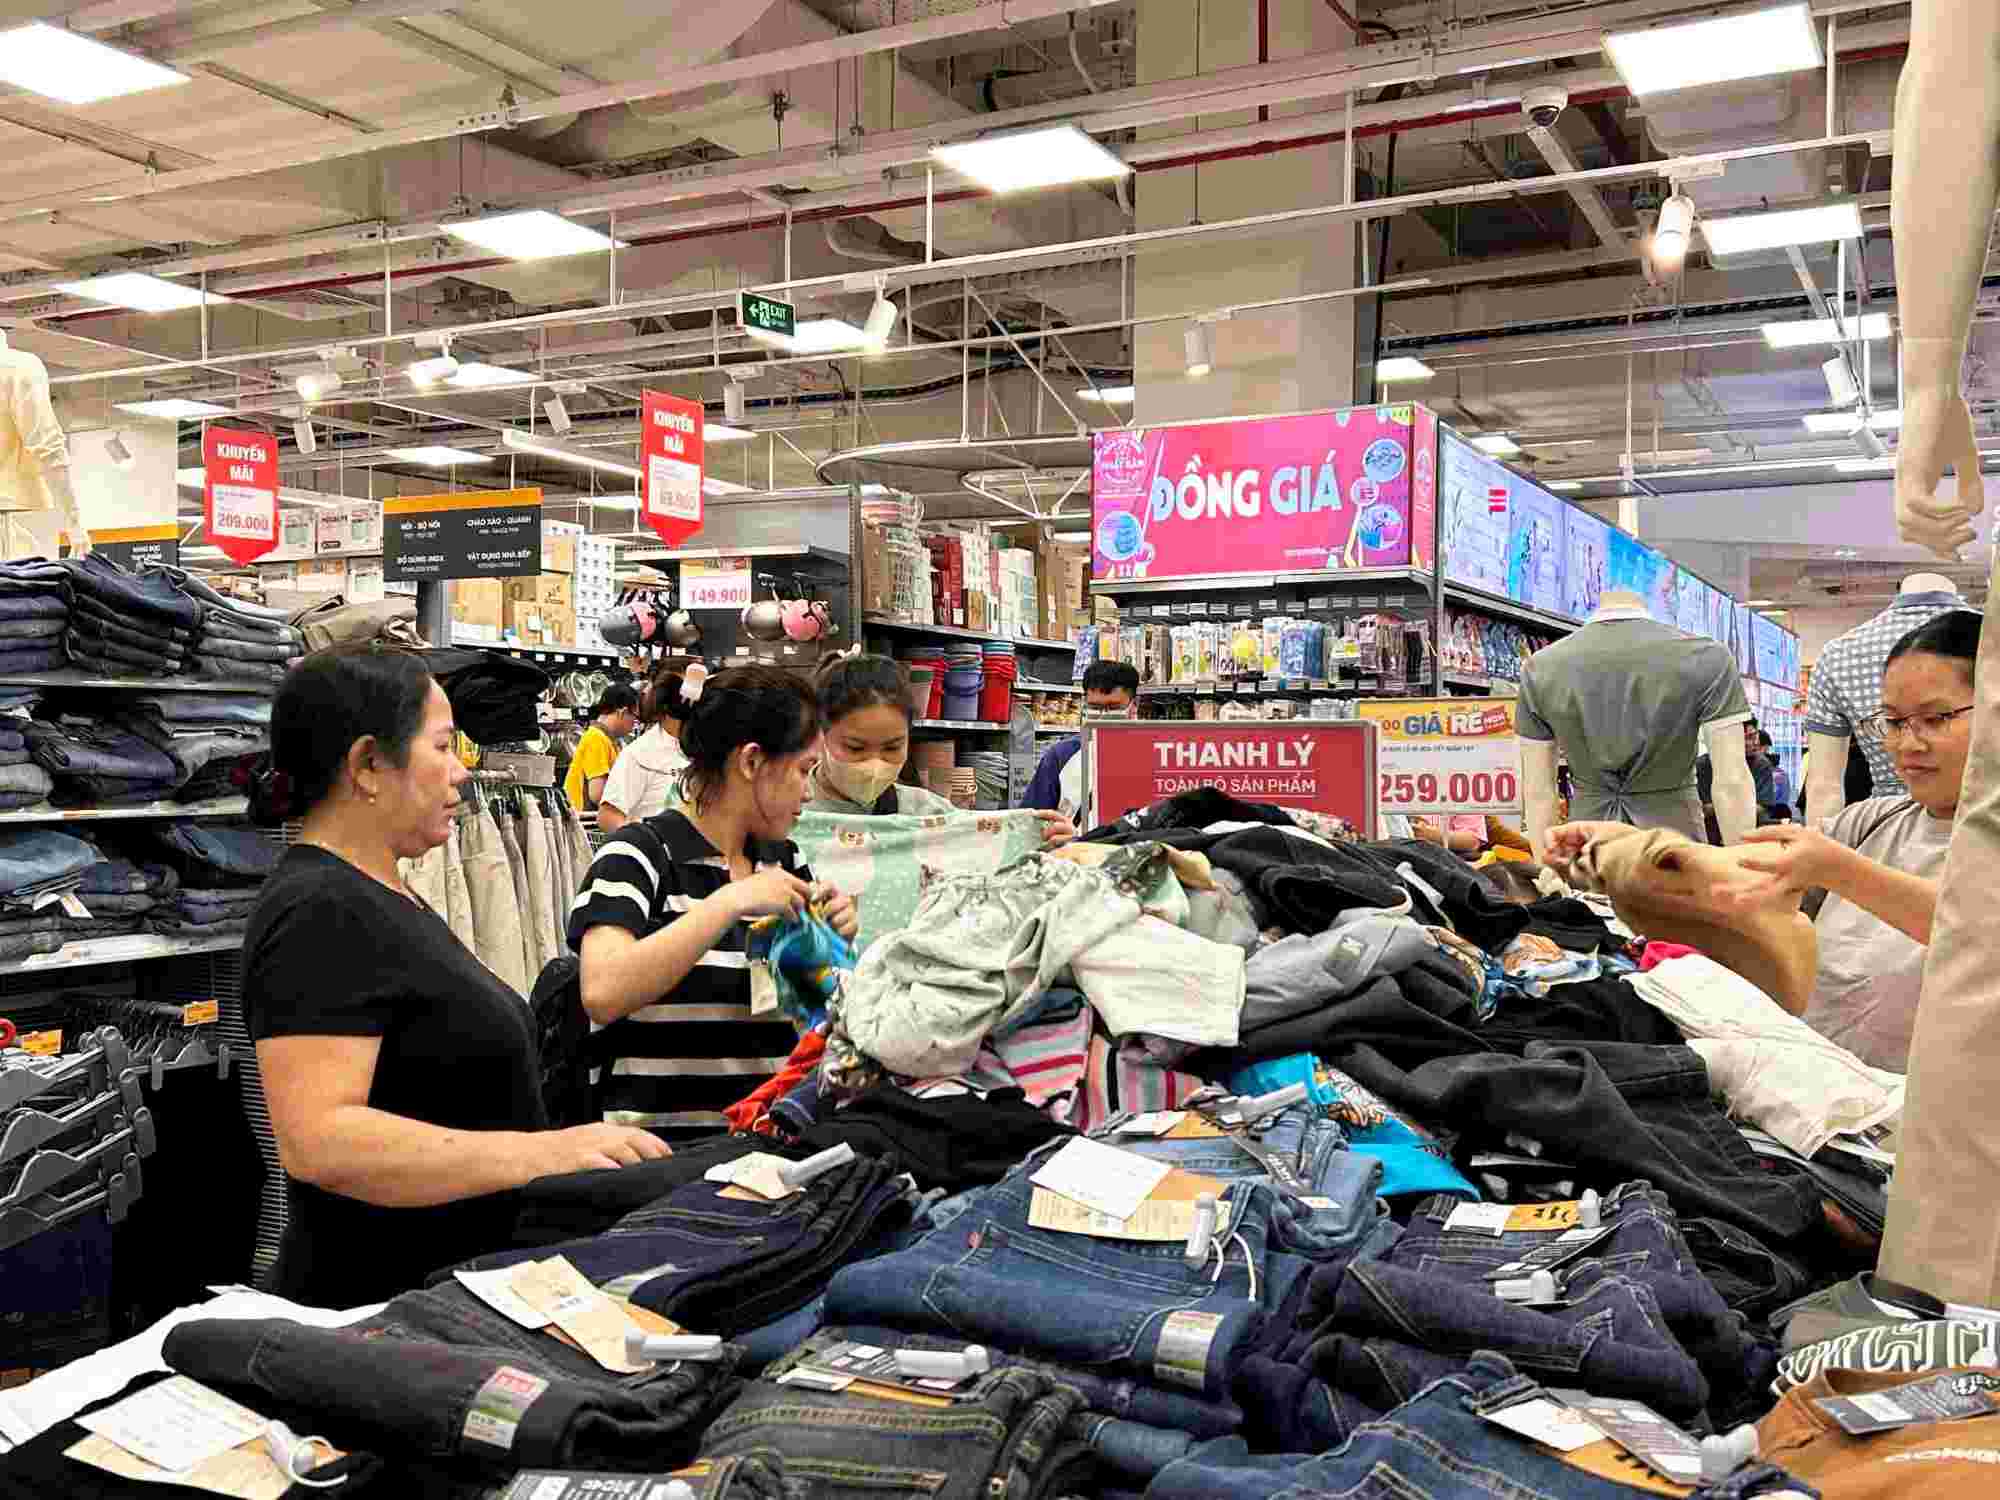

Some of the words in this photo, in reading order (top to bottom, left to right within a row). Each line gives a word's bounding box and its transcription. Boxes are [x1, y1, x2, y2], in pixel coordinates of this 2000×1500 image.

[216, 442, 267, 463] KHUYẾN
[1151, 453, 1261, 522] ĐỒNG
[1270, 449, 1343, 515] GIÁ
[1403, 709, 1442, 735] GIÁ
[1153, 741, 1269, 769] THANH
[1277, 733, 1316, 768] LÝ
